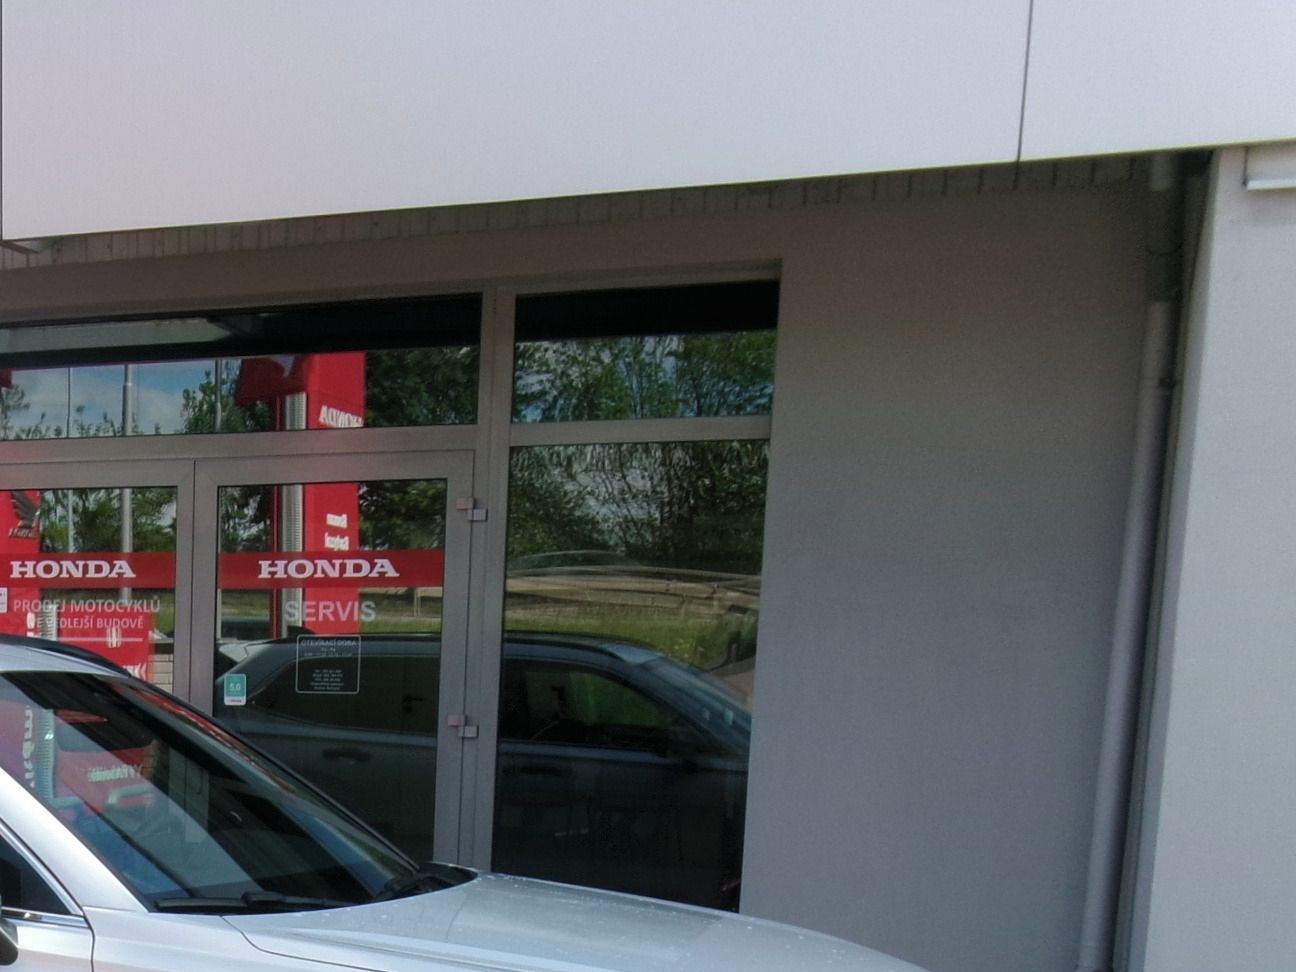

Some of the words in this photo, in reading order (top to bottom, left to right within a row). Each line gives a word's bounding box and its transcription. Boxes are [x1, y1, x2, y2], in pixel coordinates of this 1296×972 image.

[10, 560, 136, 578] HONDA
[258, 559, 400, 578] HONDA
[13, 599, 65, 613] PRODEJ
[70, 595, 161, 613] MOTOCYKLŮ
[285, 600, 376, 622] SERVIS
[96, 616, 144, 629] BUDOVĚ
